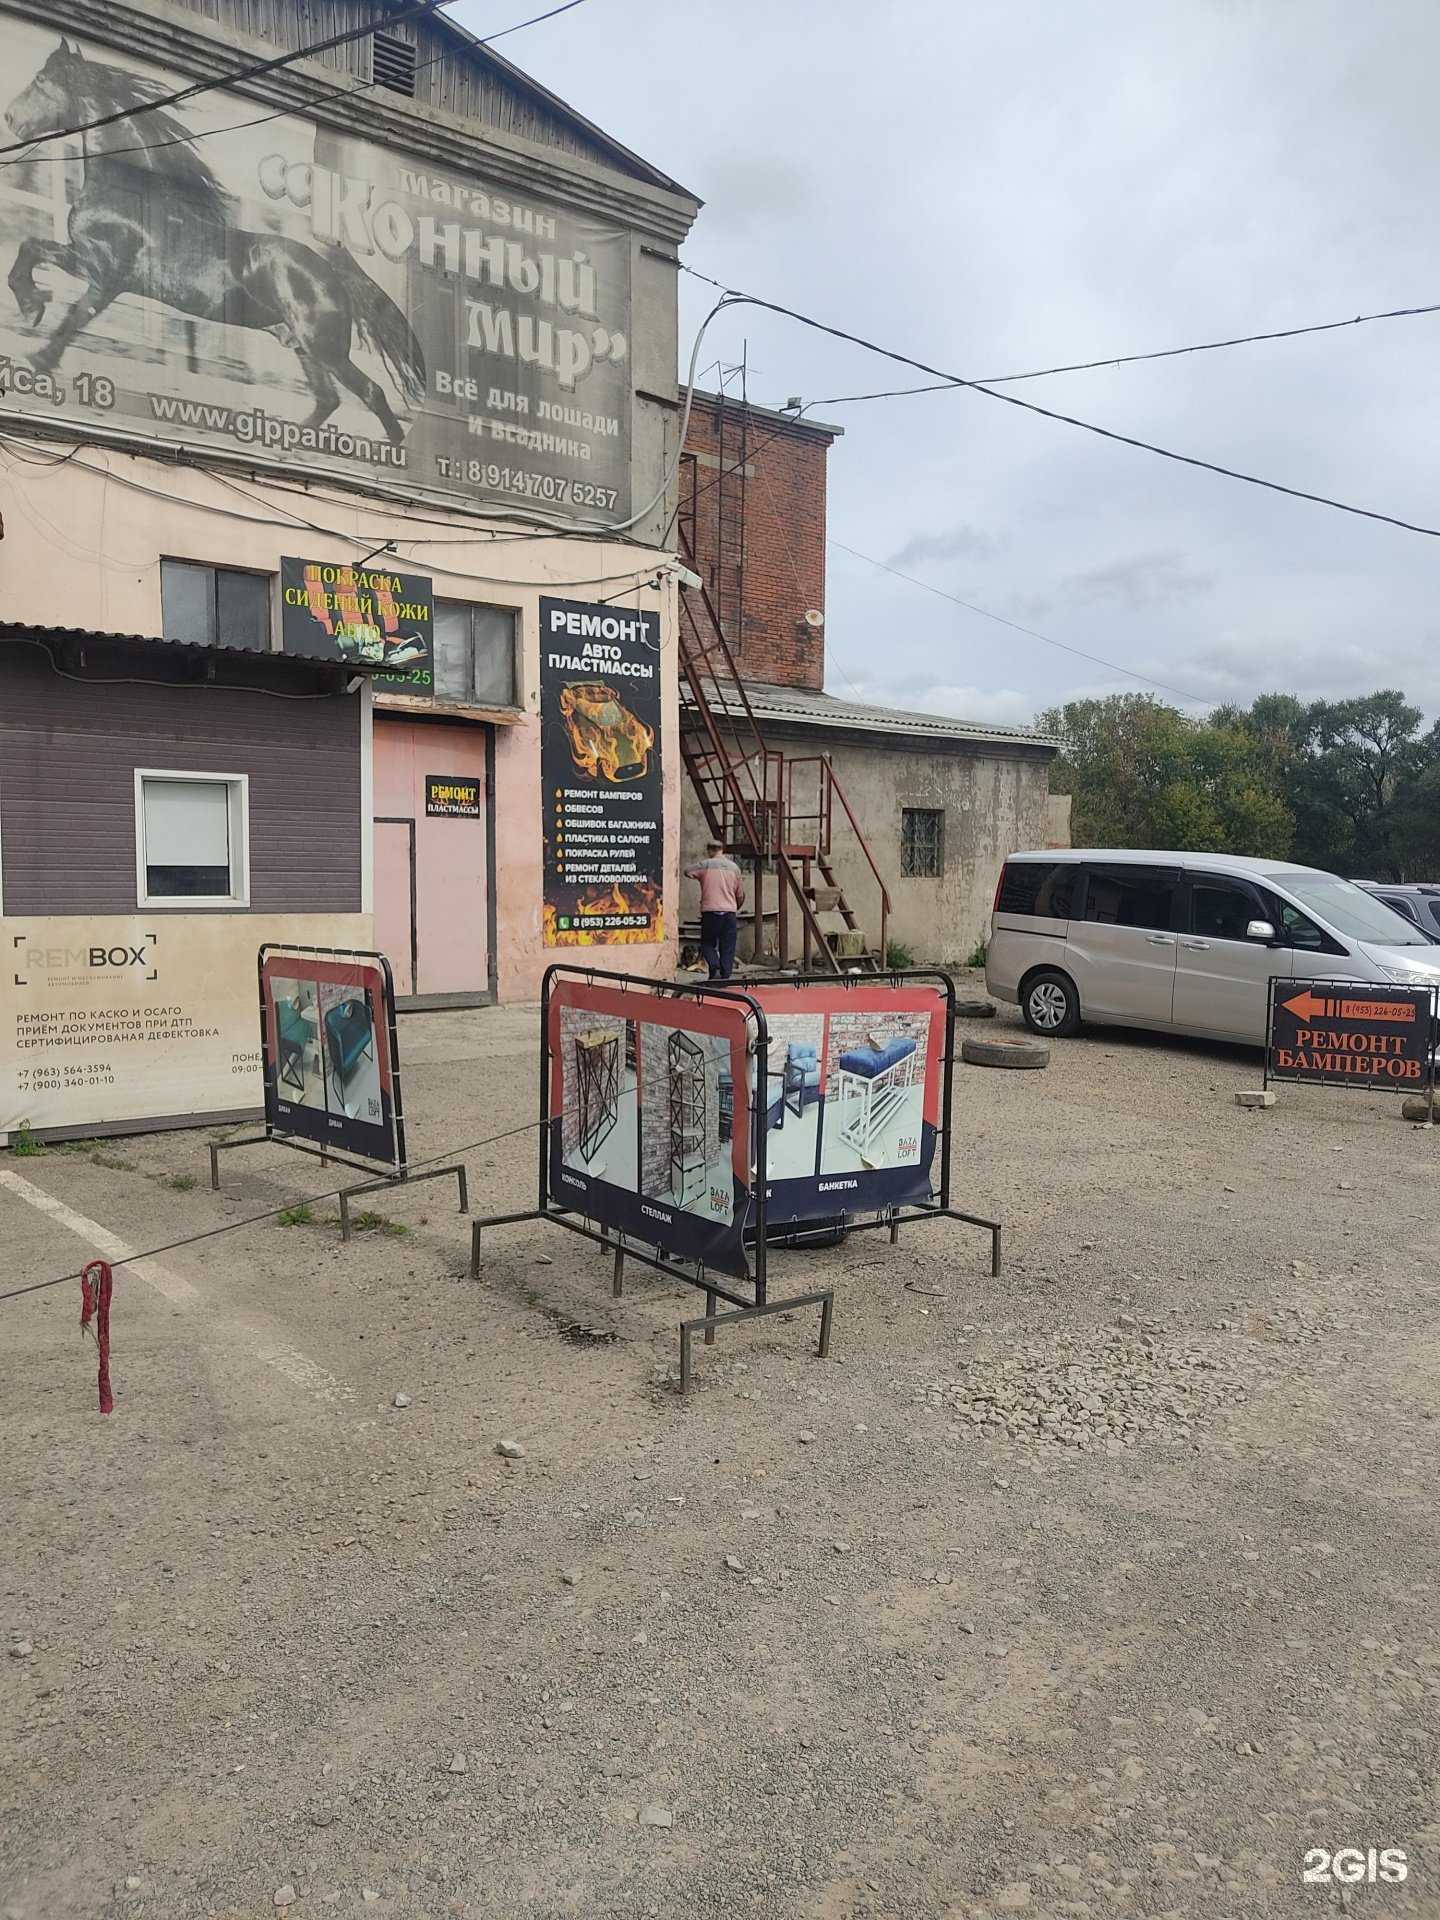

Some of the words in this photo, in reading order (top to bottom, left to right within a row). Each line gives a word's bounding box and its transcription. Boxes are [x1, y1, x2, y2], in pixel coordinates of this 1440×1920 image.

[399, 168, 557, 240] магазин
[74, 373, 115, 409] 18
[434, 369, 479, 401] Всё
[486, 387, 530, 414] для
[536, 402, 619, 437] лошади
[150, 396, 407, 467] www.gipparion.ru
[490, 420, 592, 461] всадника
[486, 462, 527, 493] 914
[531, 472, 568, 500] 707
[572, 481, 618, 510] 5257
[311, 565, 402, 593] ПОКРАСКА
[285, 588, 372, 615] СИДЕНИЙ
[377, 600, 429, 621] КОЖИ
[334, 620, 381, 642] АВТО
[550, 610, 650, 643] РЕМОНТ
[582, 643, 622, 660] АВТО
[548, 654, 653, 678] ПЛАСТМАССЫ
[431, 785, 477, 801] РЕМОНТ
[564, 789, 598, 799] РЕМОНТ
[599, 791, 643, 800] БАМПЕРОВ
[427, 803, 479, 814] ПЛАСТМАССЫ
[564, 804, 604, 814] ОБВЕСОВ
[564, 819, 607, 829] ОБШИВОК
[607, 820, 657, 830] БАГАЖНИКА
[564, 834, 609, 843] ПЛАСТИКА
[610, 835, 616, 844] В
[617, 835, 650, 844] САЛОНЕ
[565, 849, 608, 858] ПОКРАСКА
[609, 848, 636, 858] РУЛЕЙ
[565, 863, 600, 873] РЕМОНТ
[600, 862, 637, 873] ДЕТАЛЕЙ
[565, 874, 577, 884] ИЗ
[578, 874, 648, 884] СТЕКЛОВОЛОКНА
[573, 917, 580, 927] 8
[581, 917, 604, 928] (953)
[604, 915, 648, 926] 226-05-25
[16, 1012, 66, 1024] РЕМОНТ
[69, 1011, 87, 1021] ПО
[90, 1008, 129, 1019] КАСКО
[132, 1008, 141, 1018] И
[143, 1006, 182, 1017] ОСАГО
[16, 1024, 59, 1037] ПРИЁМ
[61, 1020, 142, 1034] ДОКУМЕНТОВ
[145, 1019, 169, 1029] ПРИ
[170, 1018, 193, 1029] ДТП
[16, 1032, 145, 1049] СЕРТИФИЦИРОВАНАЯ
[147, 1027, 220, 1041] ДЕФЕКТОВКА
[1295, 1029, 1407, 1055] РЕМОНТ
[232, 1053, 263, 1064] ПОНЕ
[1278, 1049, 1421, 1078] БАМПЕРОВ
[17, 1070, 29, 1079] +7
[32, 1067, 61, 1079] (963)
[63, 1063, 112, 1076] 564-3594
[17, 1082, 29, 1091] +7
[32, 1079, 61, 1092] (900)
[63, 1075, 115, 1088] 340-01-10
[561, 1173, 588, 1191] КОНСОЛЬ
[818, 1180, 858, 1192] БАНКЕТКА
[641, 1204, 673, 1224] СТЕЛЛАЖ
